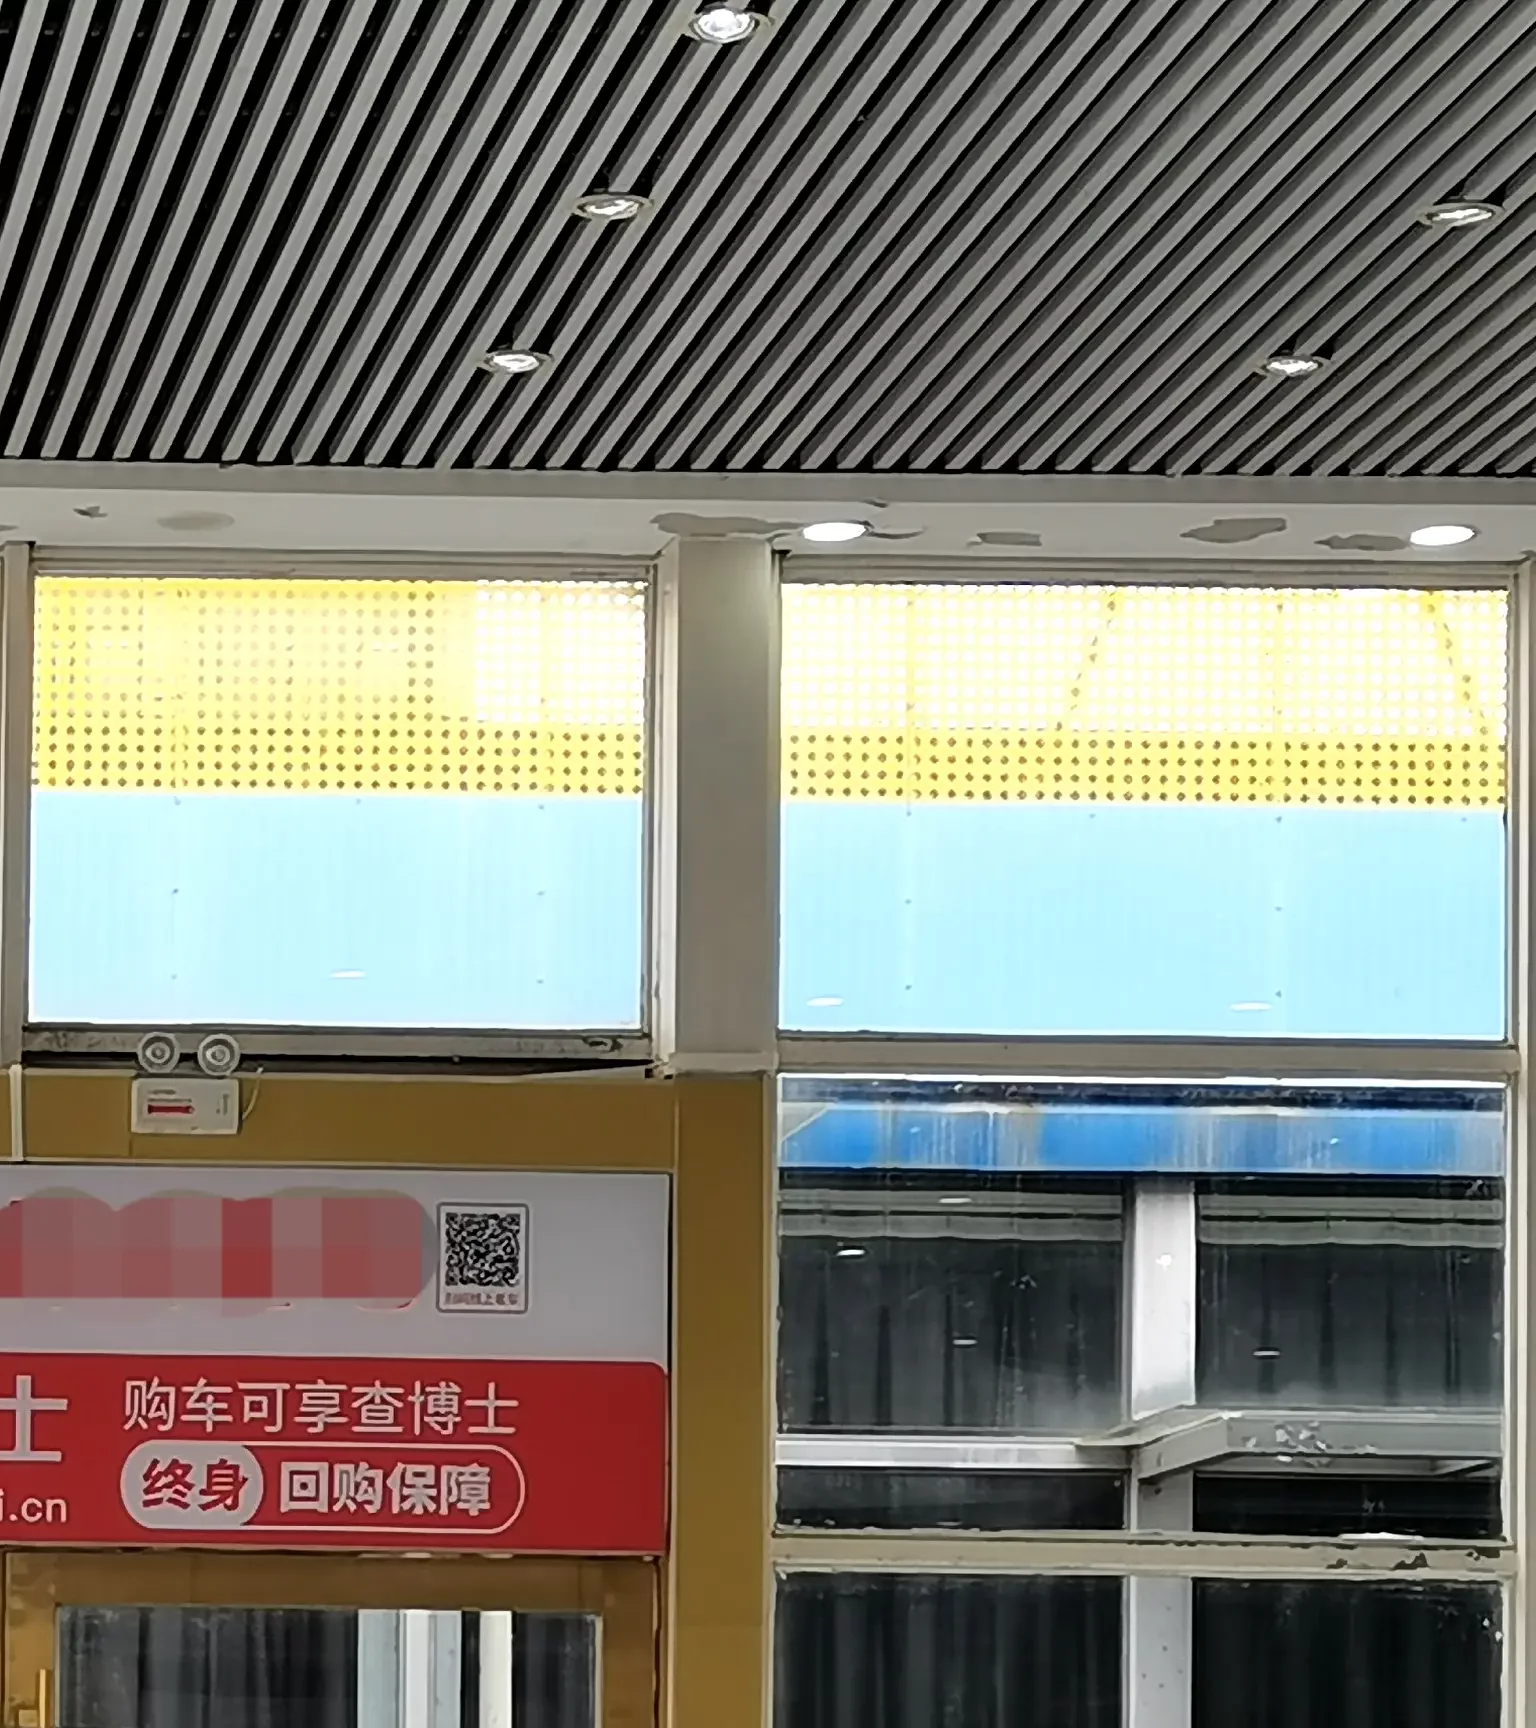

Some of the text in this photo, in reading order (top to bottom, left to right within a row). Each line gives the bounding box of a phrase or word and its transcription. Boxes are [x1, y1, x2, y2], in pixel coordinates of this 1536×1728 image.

[123, 1375, 520, 1436] 购车可享查博士
[141, 1457, 492, 1517] 终身 回购保障
